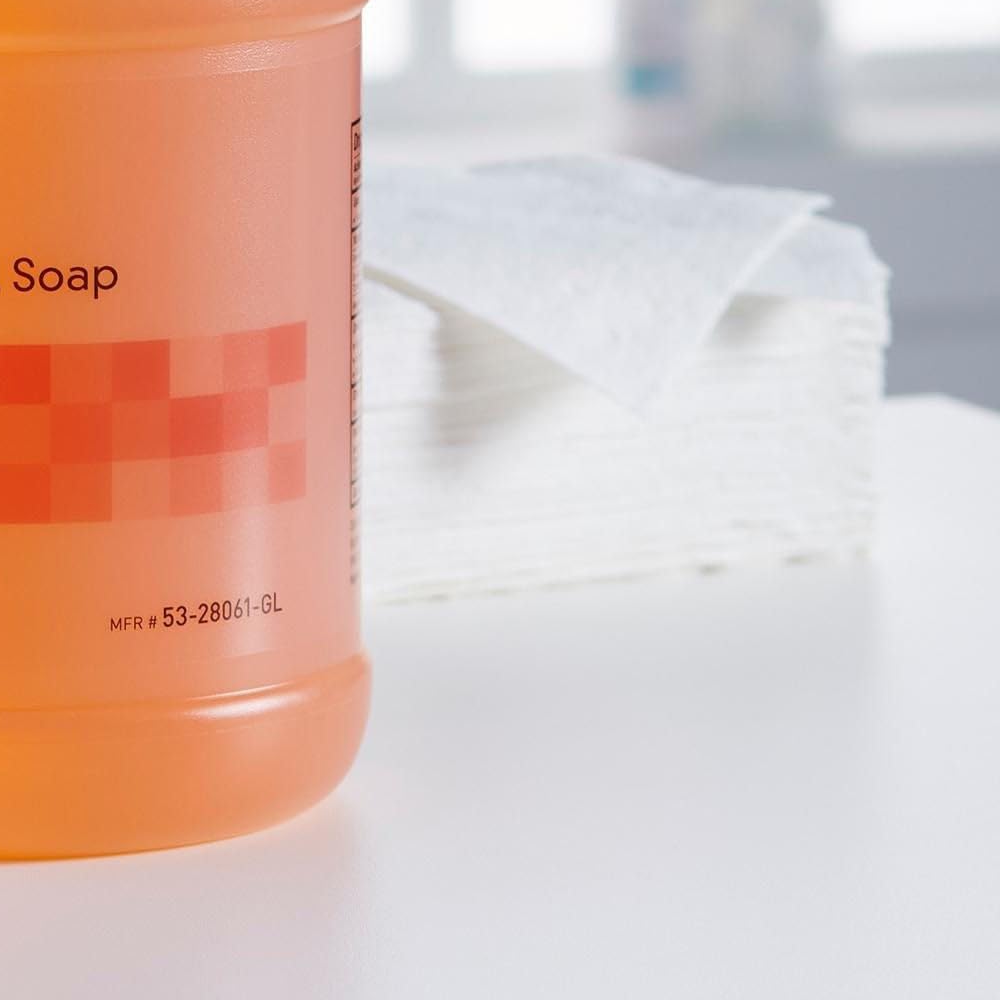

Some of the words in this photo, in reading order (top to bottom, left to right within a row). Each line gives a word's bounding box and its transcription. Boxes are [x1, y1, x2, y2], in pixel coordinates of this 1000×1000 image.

[12, 257, 119, 300] Soap
[110, 615, 143, 632] MFR
[147, 614, 158, 630] #
[162, 592, 283, 628] 53-28061-GL
